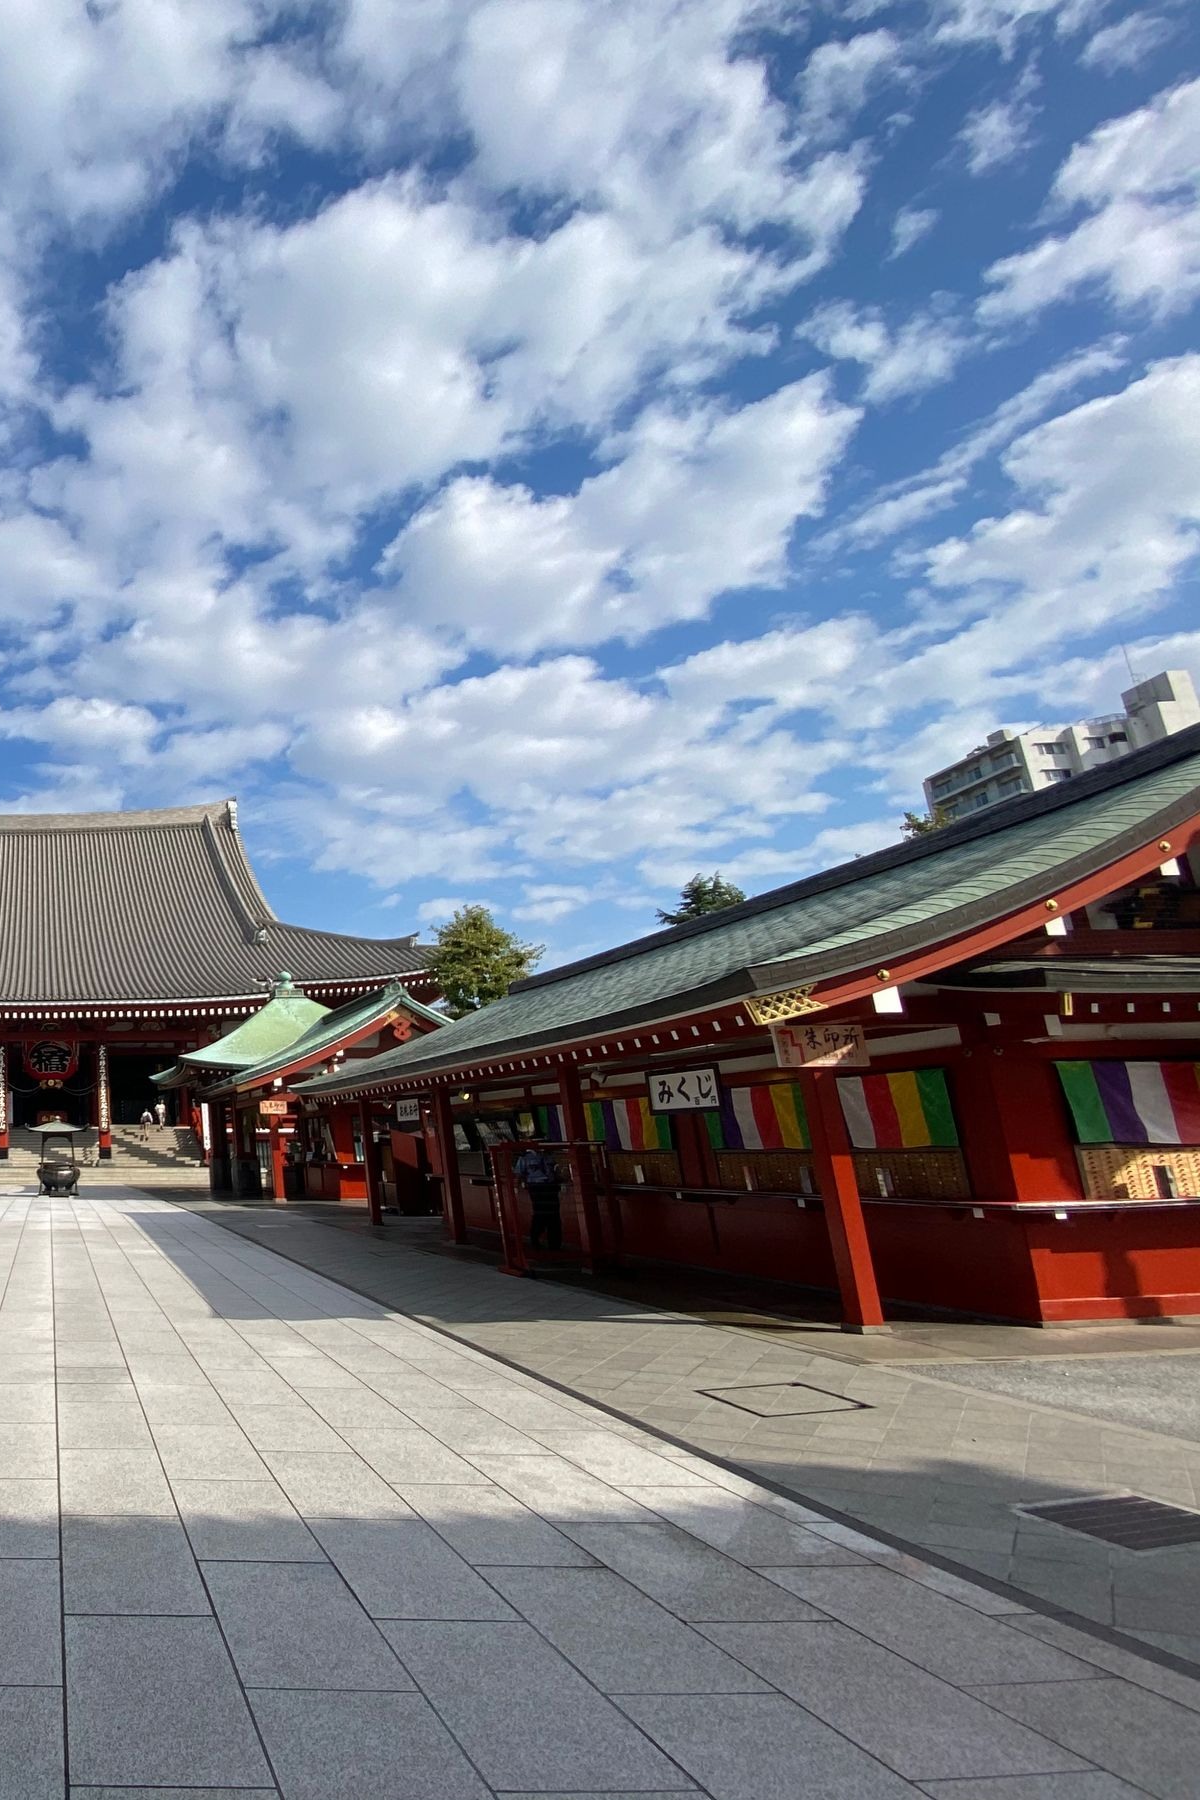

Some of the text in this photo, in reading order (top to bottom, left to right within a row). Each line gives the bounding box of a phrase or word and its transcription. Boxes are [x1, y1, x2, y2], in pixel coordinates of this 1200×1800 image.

[804, 1027, 860, 1050] 朱印所
[658, 1074, 712, 1104] みくじ
